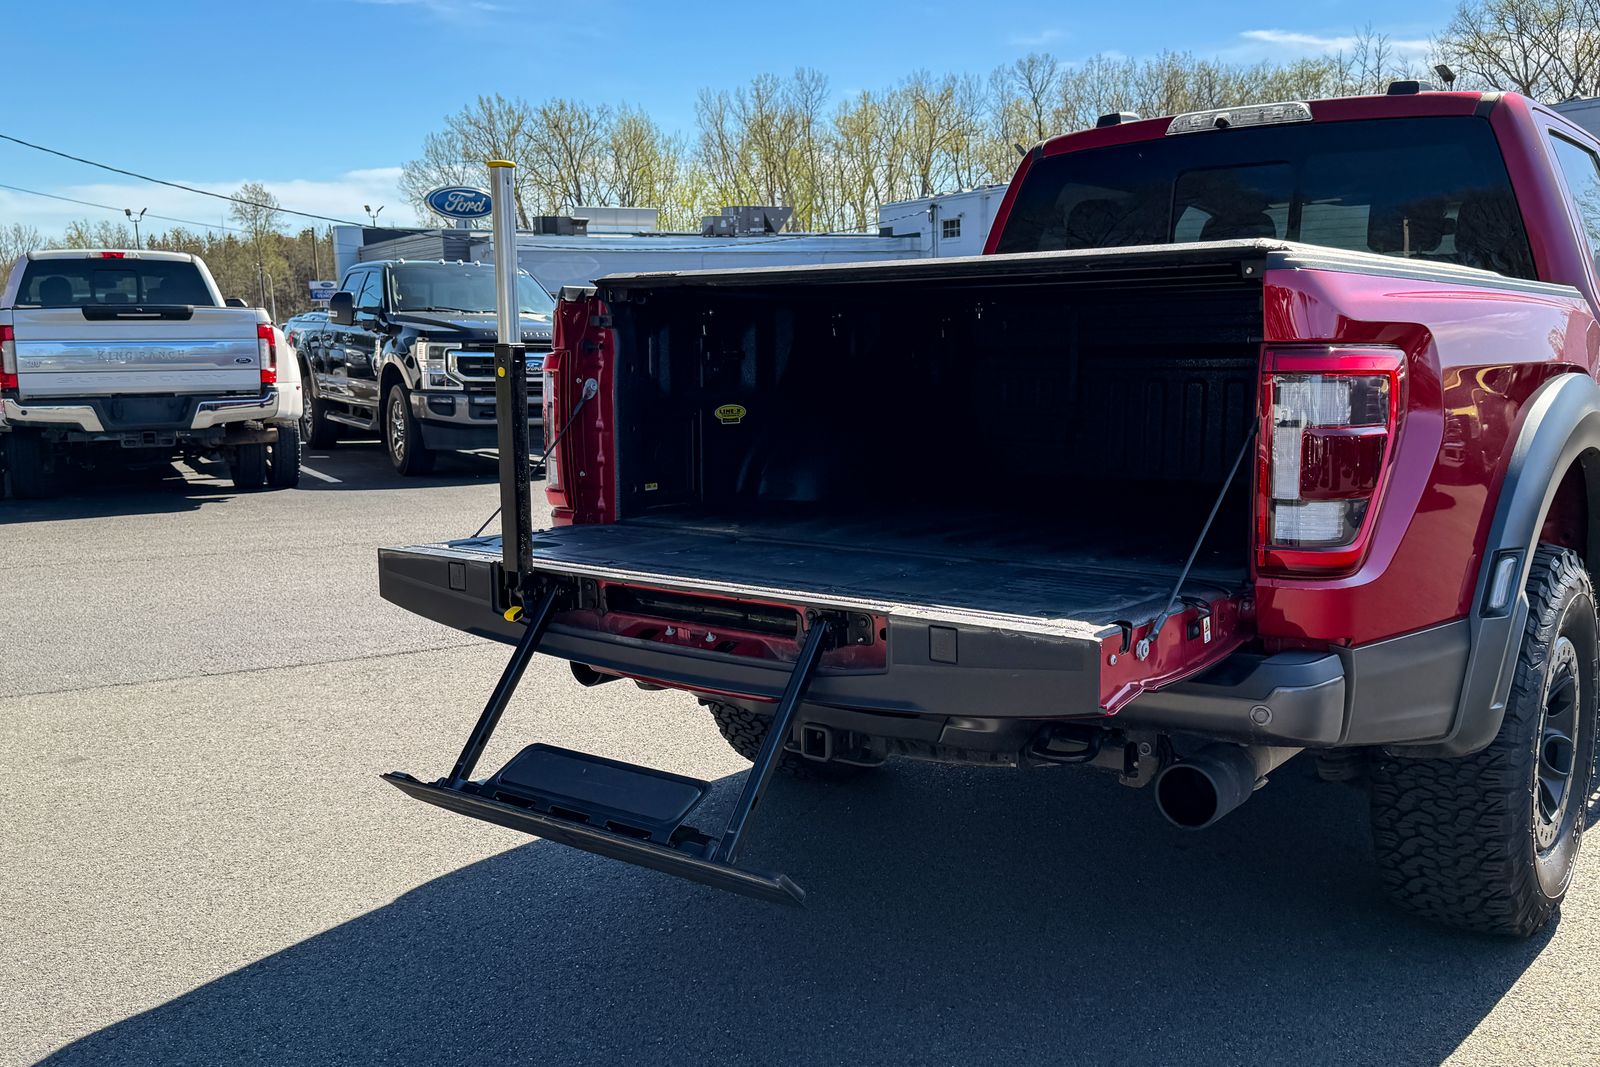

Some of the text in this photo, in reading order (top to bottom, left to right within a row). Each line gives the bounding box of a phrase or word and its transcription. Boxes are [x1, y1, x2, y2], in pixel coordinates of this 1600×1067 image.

[444, 191, 486, 212] Ford
[96, 350, 185, 361] KING RANCH
